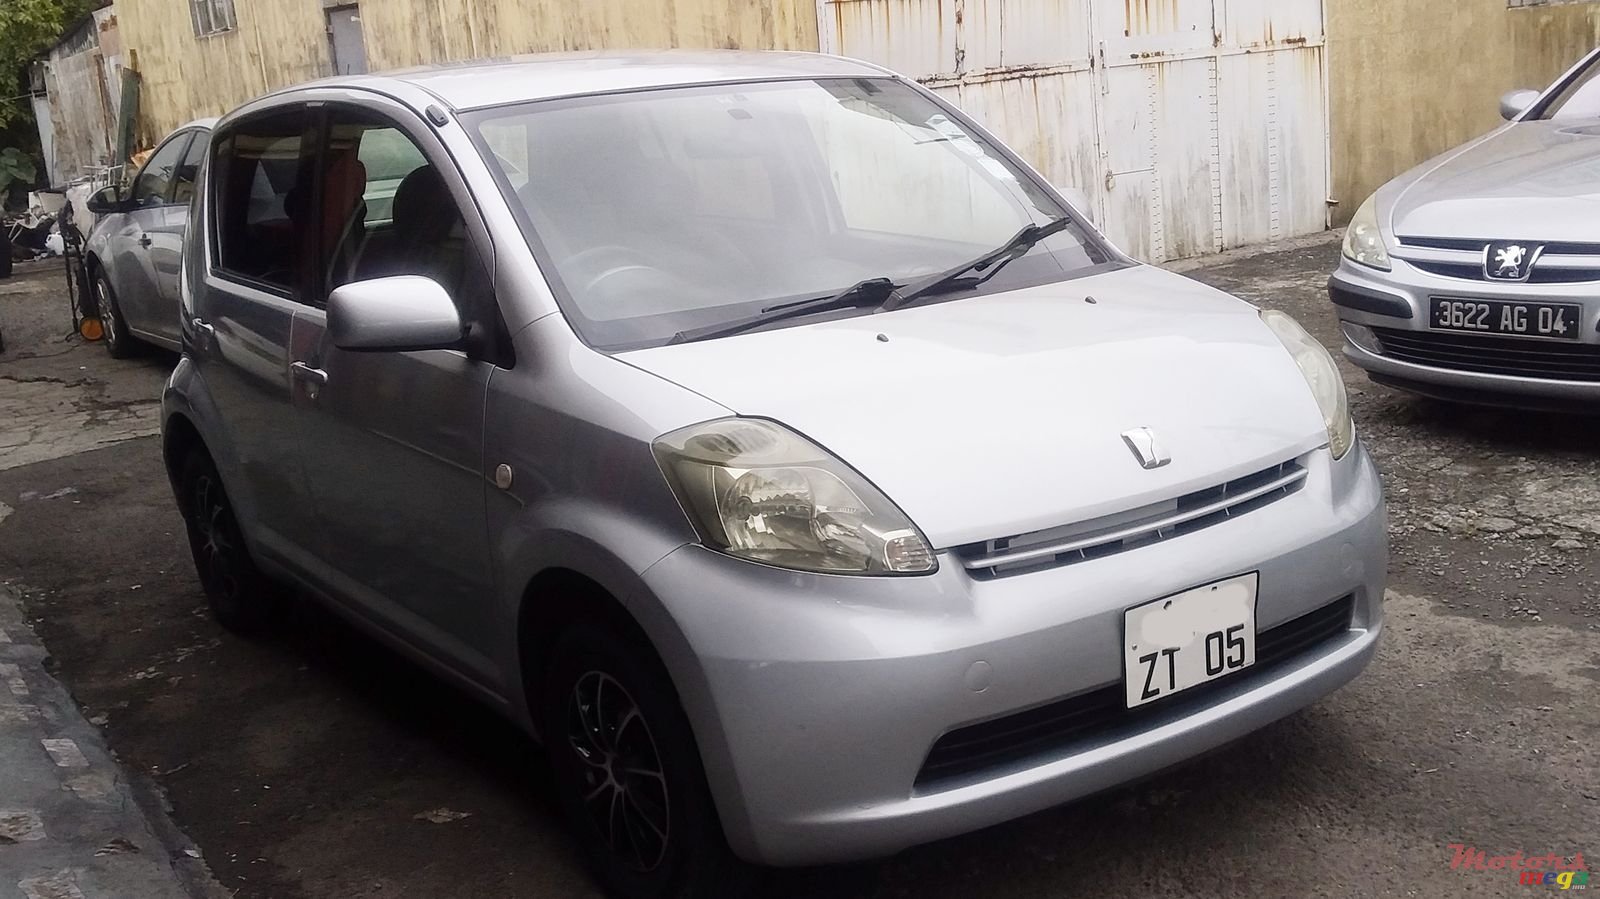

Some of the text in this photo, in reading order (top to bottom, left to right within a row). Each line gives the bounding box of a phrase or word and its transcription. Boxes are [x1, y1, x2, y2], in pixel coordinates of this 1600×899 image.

[1439, 302, 1567, 334] 3622 AG 04
[1139, 623, 1245, 700] ZT 05
